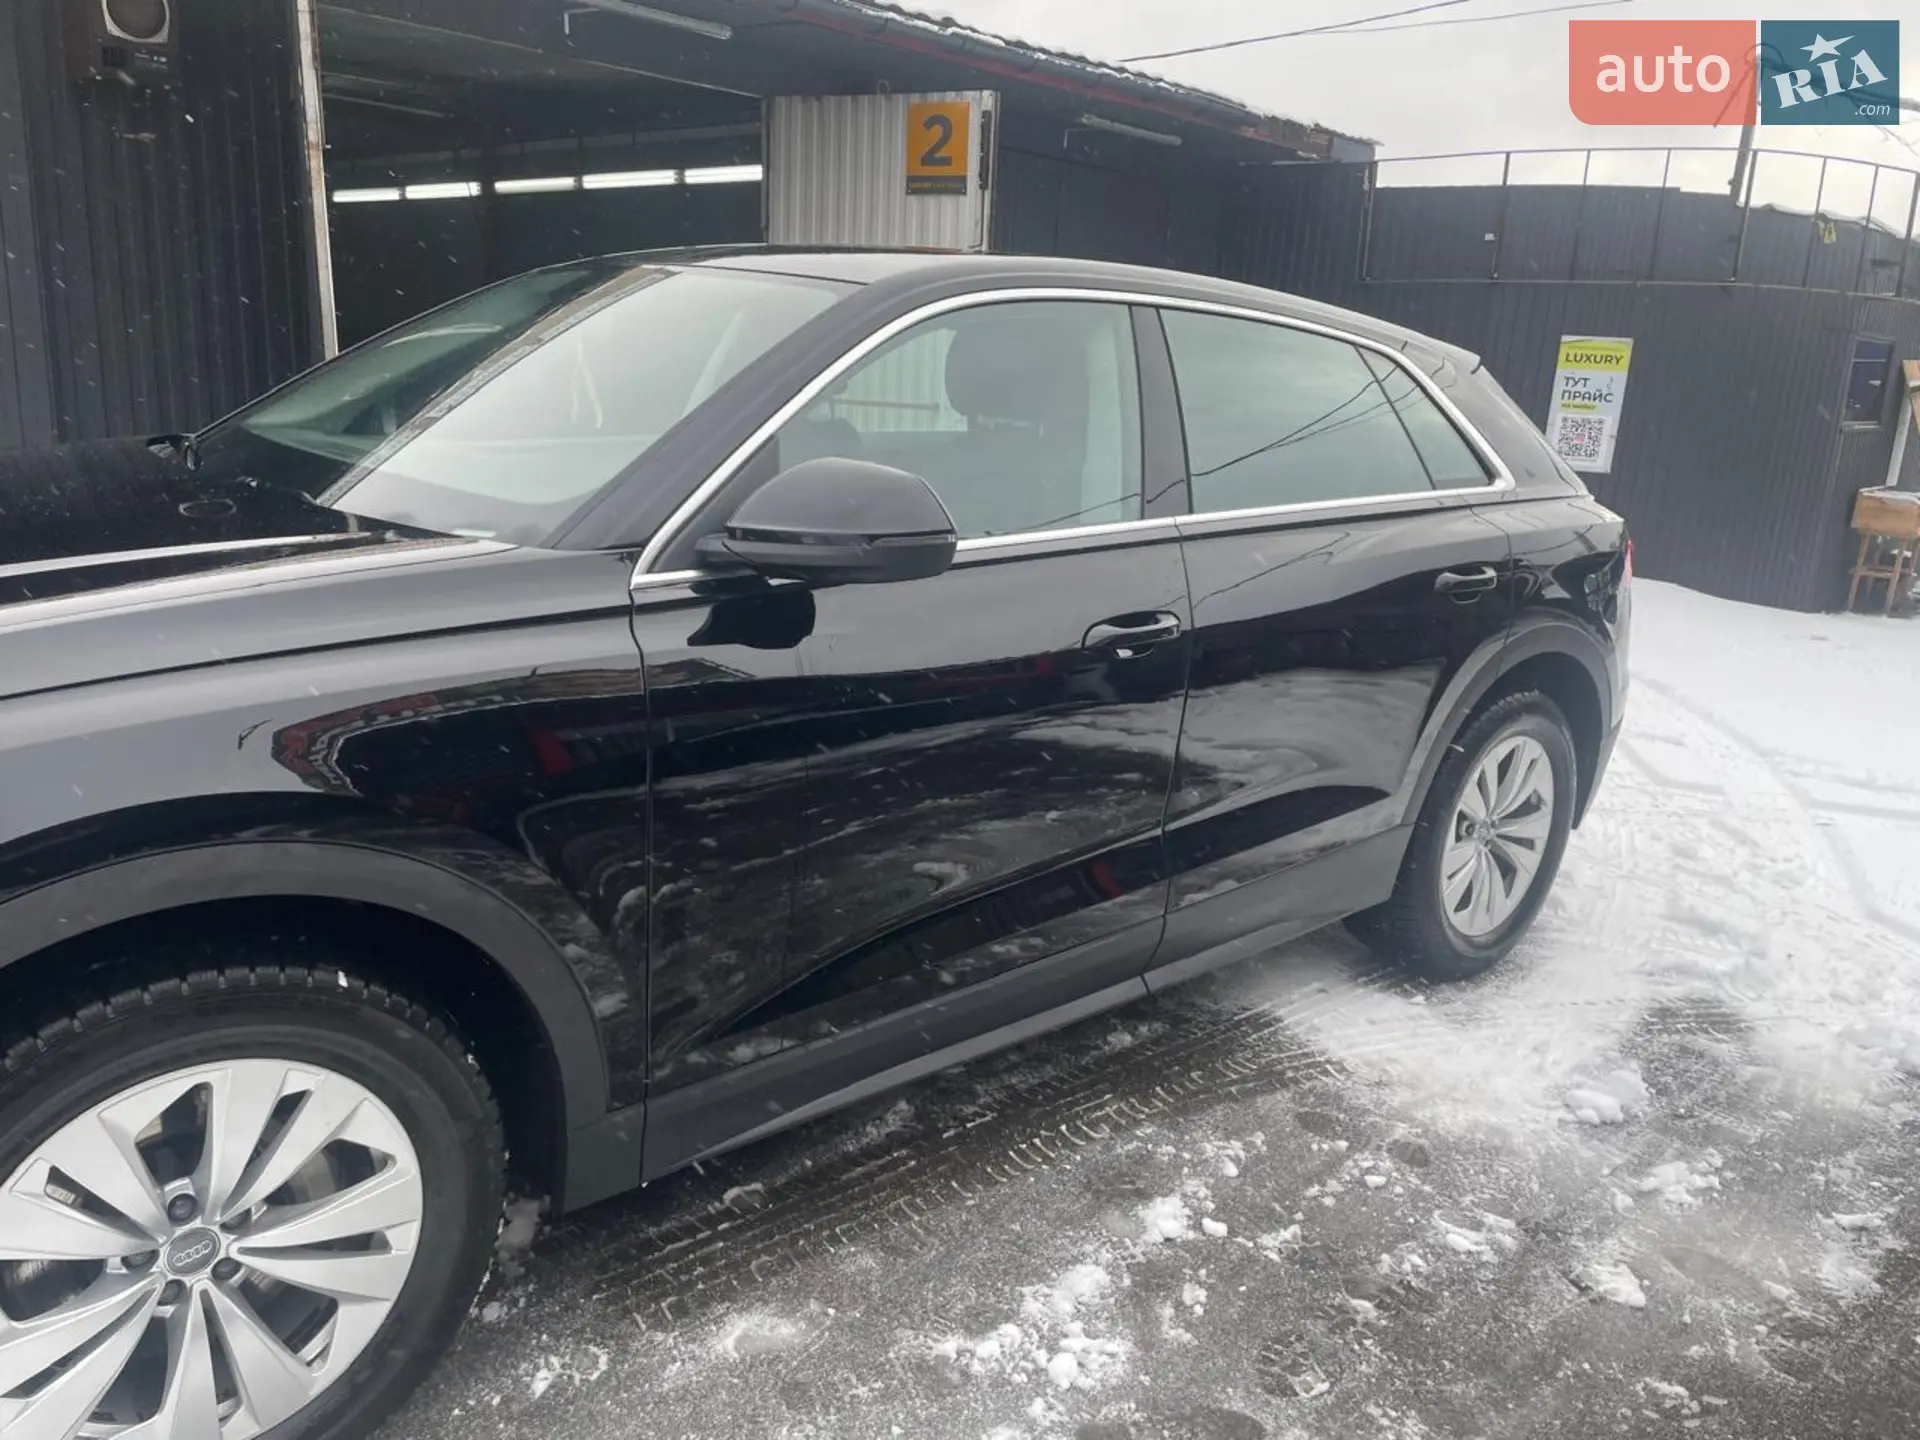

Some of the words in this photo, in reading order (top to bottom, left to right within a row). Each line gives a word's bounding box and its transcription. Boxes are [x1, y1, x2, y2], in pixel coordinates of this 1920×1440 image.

[920, 113, 953, 167] 2
[1565, 352, 1624, 365] LUXURY
[1563, 376, 1590, 388] ТУТ
[1561, 389, 1614, 403] ПРАЙС
